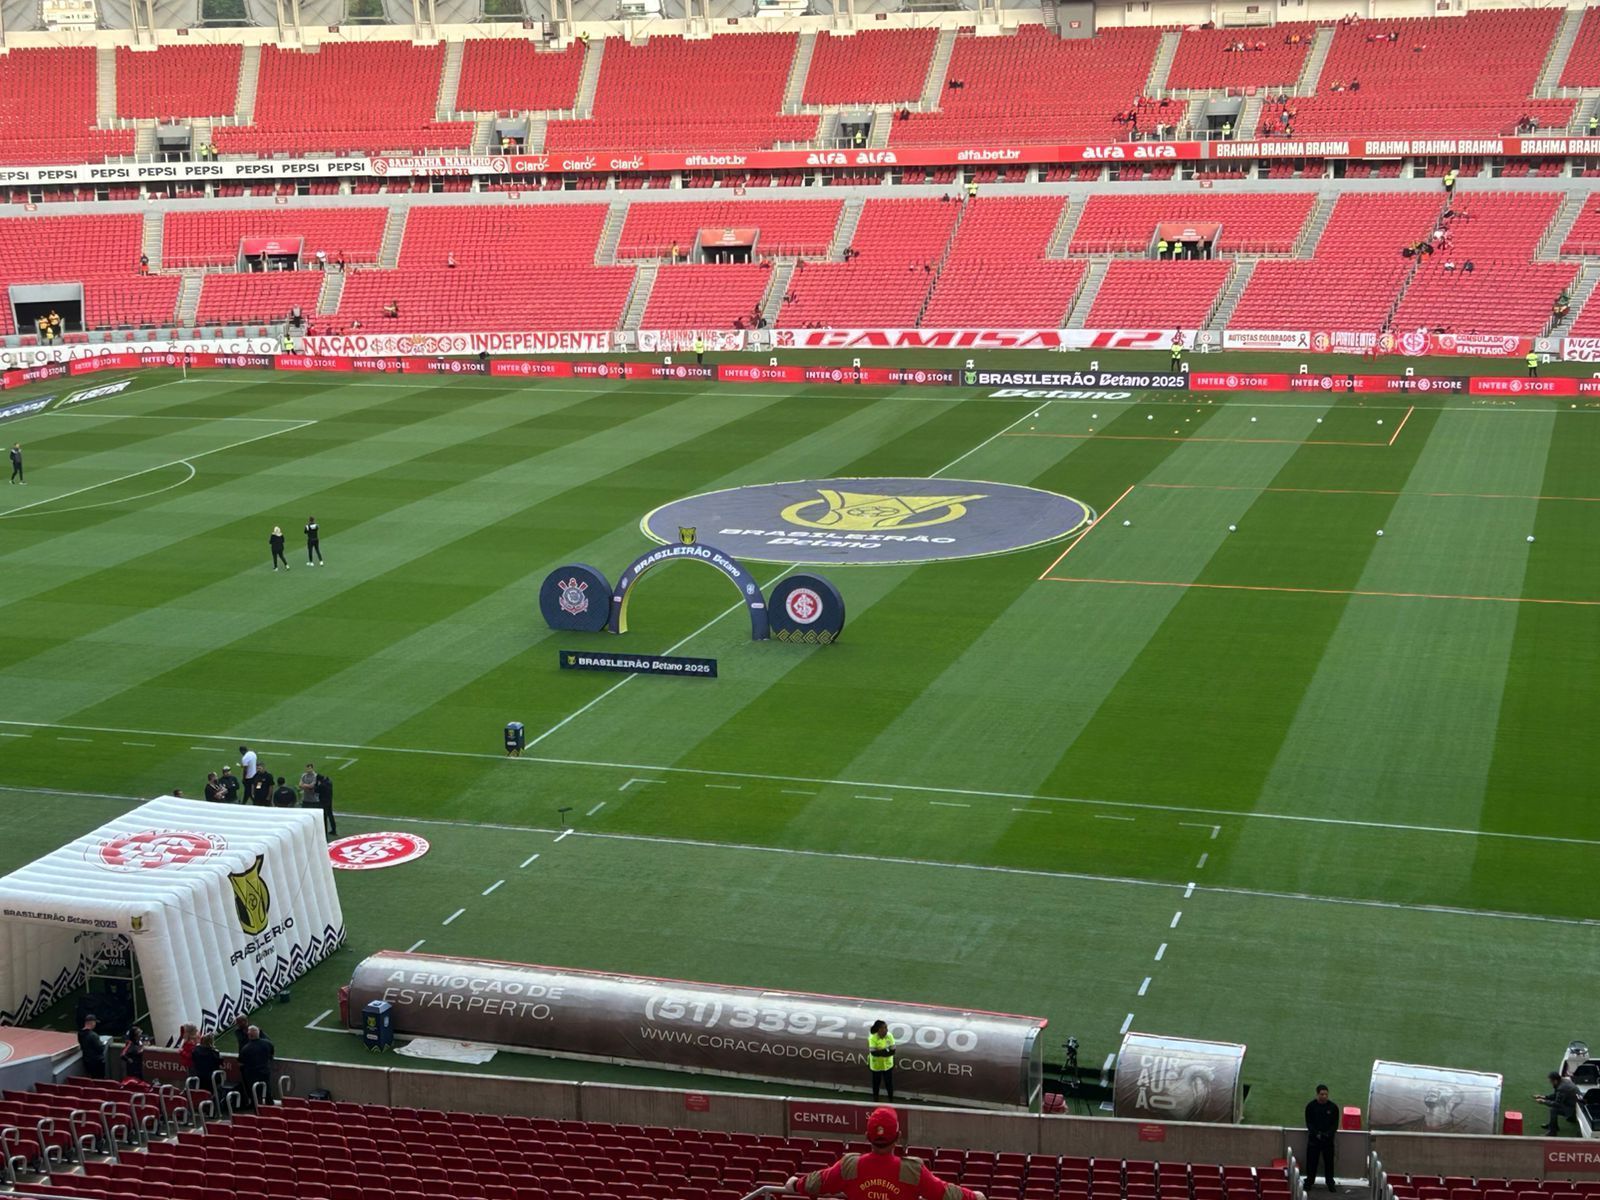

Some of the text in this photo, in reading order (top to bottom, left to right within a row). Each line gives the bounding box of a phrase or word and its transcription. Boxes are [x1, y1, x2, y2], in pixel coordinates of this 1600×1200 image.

[1216, 141, 1349, 157] BRAHMA BRAHMA BRAHMA
[1365, 140, 1503, 155] BRAHMA BRAHMA BRAHMA
[1520, 139, 1600, 154] BRAHMA BRAH
[685, 155, 748, 166] alfa.bet.br
[957, 149, 1021, 161] alfa.bet.br
[388, 156, 491, 169] SALDANHA MARINHO
[515, 161, 545, 171] Claro
[562, 160, 592, 170] Claro
[609, 159, 639, 169] Claro
[38, 169, 78, 181] PEPSI
[90, 168, 130, 179] PEPSI
[138, 166, 177, 178] PEPSI
[184, 165, 224, 176] PEPSI
[235, 164, 274, 175] PEPSI
[282, 163, 320, 173] PEPSI
[327, 162, 366, 172] PEPSI
[469, 332, 607, 352] INDEPENDENTE
[804, 331, 1060, 347] CAMISA
[1228, 334, 1296, 344] AUTISTAS COLORADOS
[176, 356, 198, 364] SORE
[214, 356, 270, 366] INTER STORE
[280, 357, 337, 368] INTER STORE
[353, 360, 410, 371] INTER STORE
[427, 362, 486, 373] INTER STORE
[496, 363, 556, 373] INTER STORE
[573, 365, 633, 375] INTER STORE
[651, 367, 713, 378] INTER STORE
[724, 368, 787, 379] INTER STORE
[805, 370, 869, 381] INTER STORE
[888, 372, 954, 383] INTER STORE
[978, 371, 1185, 388] BRASILEIRÃO Betano 2025
[1197, 376, 1269, 387] INTER STORE
[1291, 378, 1364, 389] INTER STORE
[1387, 380, 1463, 390] INTER STORE
[1477, 381, 1556, 391] INTER STORE
[719, 528, 957, 544] BRASILEIRÃO
[634, 546, 741, 577] BRASILEIRÃO Betano
[578, 656, 711, 673] BRASILEIRÃO Betano 2025
[3, 909, 66, 922] BRASILEIRÃO
[94, 919, 118, 929] 2025
[387, 970, 405, 983] A
[527, 985, 566, 1000] DE
[382, 987, 465, 1011] ESTAR
[645, 995, 979, 1053] (51) 3392.000
[640, 1026, 974, 1078] WWW.CORACAODOGIGAN.COM.BR
[145, 1059, 186, 1073] CENTRA
[794, 1112, 850, 1126] CENTRAL
[859, 1178, 901, 1195] BOMBEIRO
[867, 1190, 889, 1200] CIVIL
